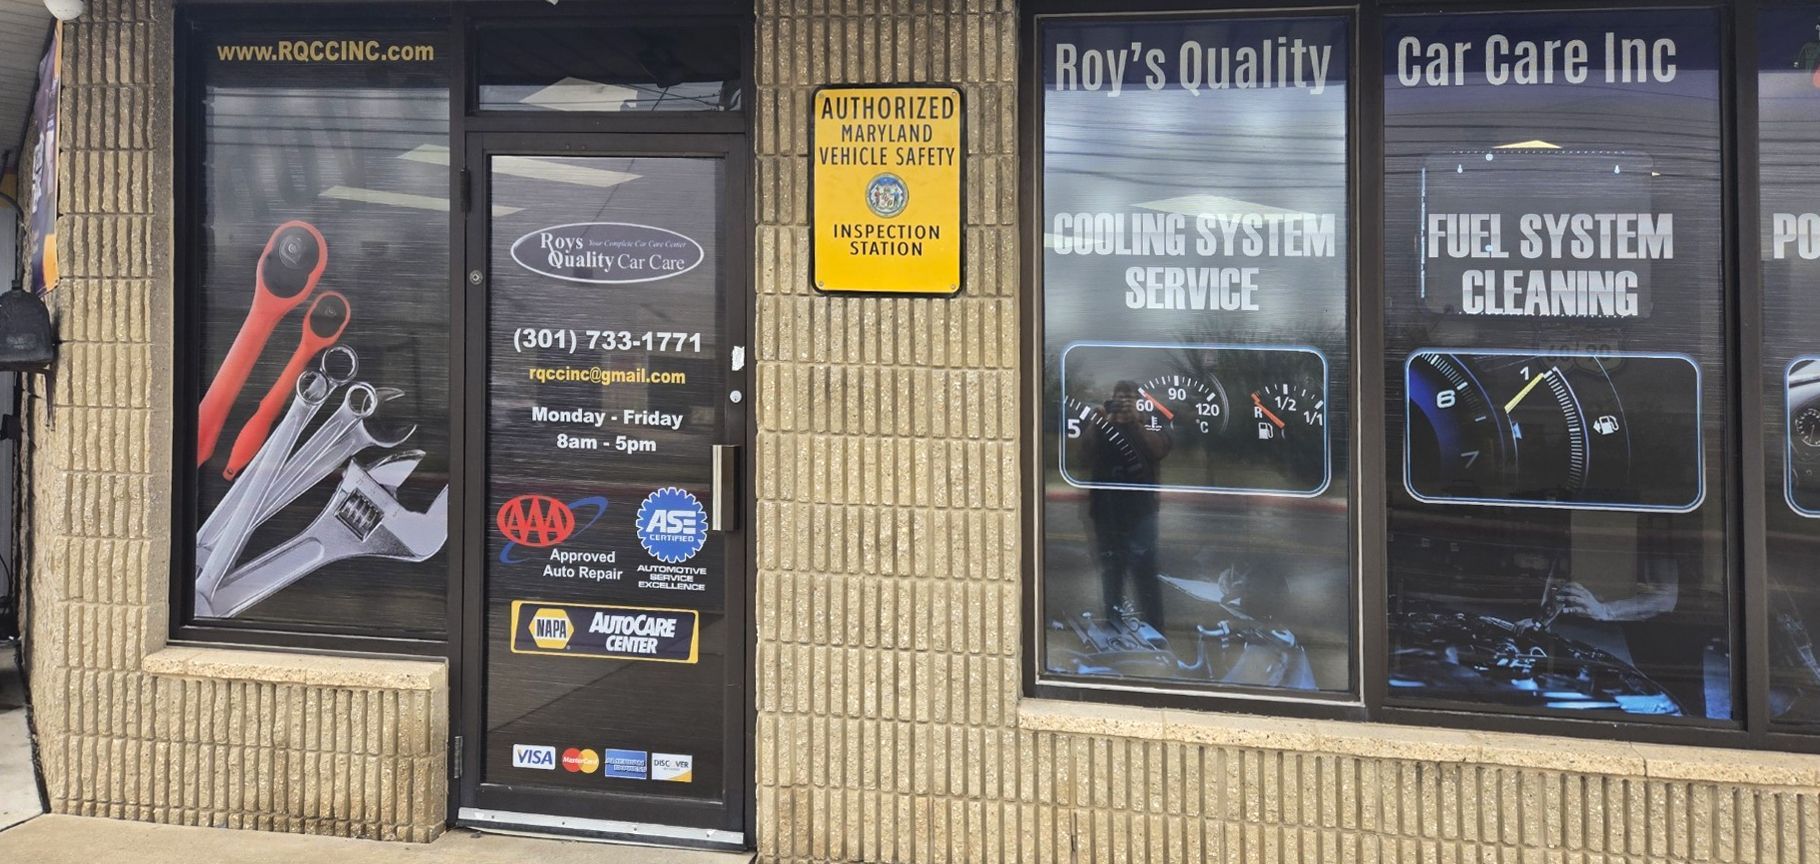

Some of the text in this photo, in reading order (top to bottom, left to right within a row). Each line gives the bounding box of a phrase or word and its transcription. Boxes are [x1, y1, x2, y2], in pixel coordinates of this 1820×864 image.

[217, 40, 435, 63] www.RQCCINC.com
[1397, 31, 1677, 87] Car Care Inc
[1056, 36, 1332, 98] Roy's Quality
[821, 96, 954, 120] AUTHORIZED
[841, 124, 933, 143] MARYLAND
[820, 147, 955, 166] VEHICLE SAFETY
[833, 224, 940, 239] INSPECTION
[1053, 212, 1336, 258] COOLING SYSTEM
[1427, 213, 1674, 260] FUEL SYSTEM
[540, 232, 584, 252] Roys
[603, 239, 633, 249] Complete
[648, 240, 663, 248] Care
[850, 241, 923, 256] STATION
[548, 250, 685, 273] Quality Car Care
[1125, 266, 1260, 311] SERVICE
[1462, 269, 1639, 317] CLEANING
[513, 328, 702, 354] (301) 733-1771
[529, 367, 686, 387] rqccinc@gmail.com
[1168, 387, 1187, 401] 90
[1436, 389, 1456, 409] 6
[1136, 399, 1154, 412] 60
[1195, 403, 1220, 417] 120
[1275, 396, 1297, 412] 1/2
[532, 406, 606, 427] Monday
[623, 409, 683, 430] Friday
[1067, 419, 1081, 438] 5
[556, 434, 597, 450] 8am
[615, 435, 657, 454] 5pm
[497, 495, 575, 547] AAA
[646, 509, 697, 534] ASE
[649, 534, 694, 543] CERTIFIED
[550, 548, 616, 565] Approved
[542, 565, 624, 582] Auto Repair
[637, 565, 707, 575] AUTOMOTIVE
[649, 574, 694, 583] SERVICE
[638, 581, 706, 591] EXCELLENCE
[536, 618, 568, 639] NAPA
[606, 636, 659, 654] CENTER
[517, 749, 553, 765] VISA
[653, 759, 690, 768] DISCVER
